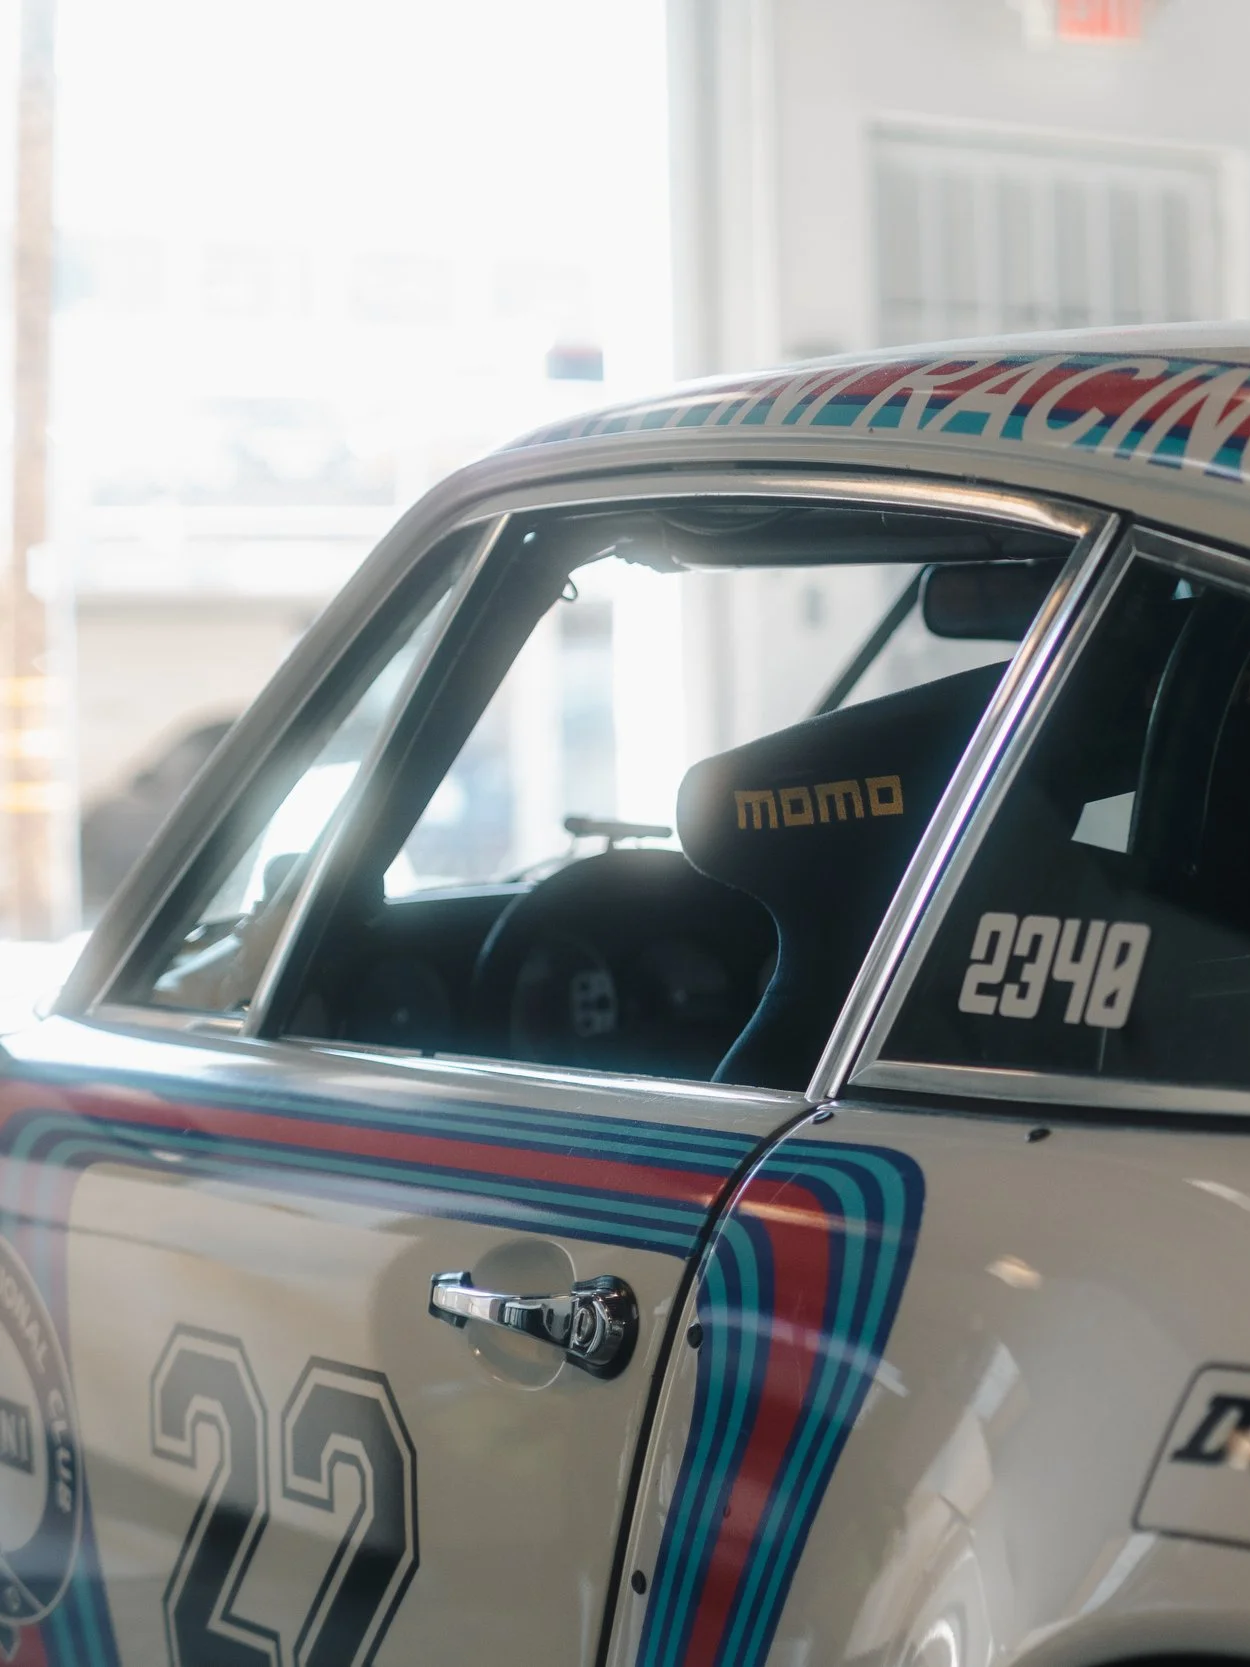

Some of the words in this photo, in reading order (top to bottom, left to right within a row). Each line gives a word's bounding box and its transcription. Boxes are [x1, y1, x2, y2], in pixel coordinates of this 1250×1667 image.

[734, 775, 904, 830] momo
[958, 911, 1151, 1029] 2340
[46, 1387, 73, 1514] CLUB
